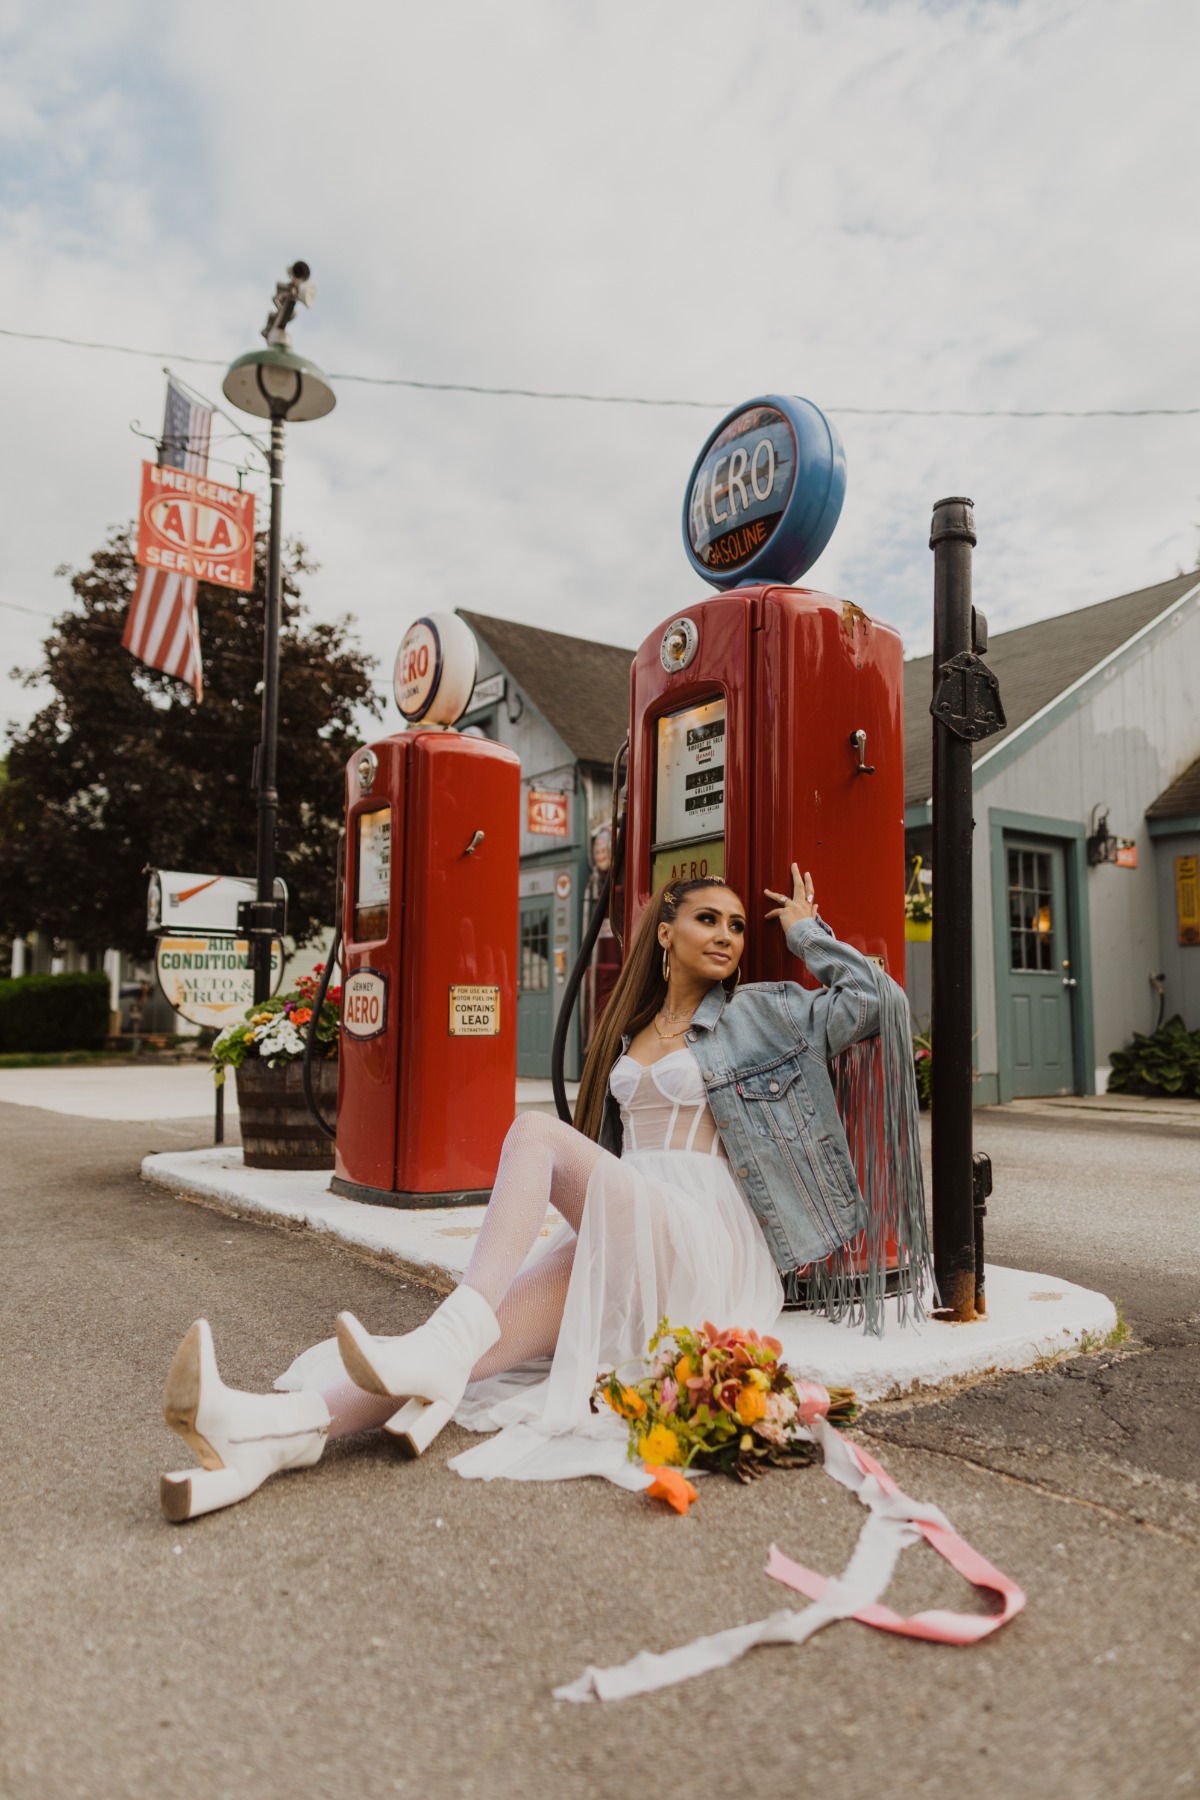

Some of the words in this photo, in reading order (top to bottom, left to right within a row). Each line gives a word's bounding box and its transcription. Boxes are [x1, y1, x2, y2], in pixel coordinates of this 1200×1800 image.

[150, 466, 249, 509] EMERGENCY
[693, 438, 775, 536] AERO
[162, 504, 231, 549] ALA
[708, 521, 767, 565] GASOLINE
[146, 546, 245, 586] SERVICE
[208, 938, 234, 951] AIR
[352, 981, 374, 992] JENNEY
[346, 995, 379, 1025] AERO
[455, 1004, 495, 1012] CONTAINS
[462, 1015, 489, 1025] LEAD
